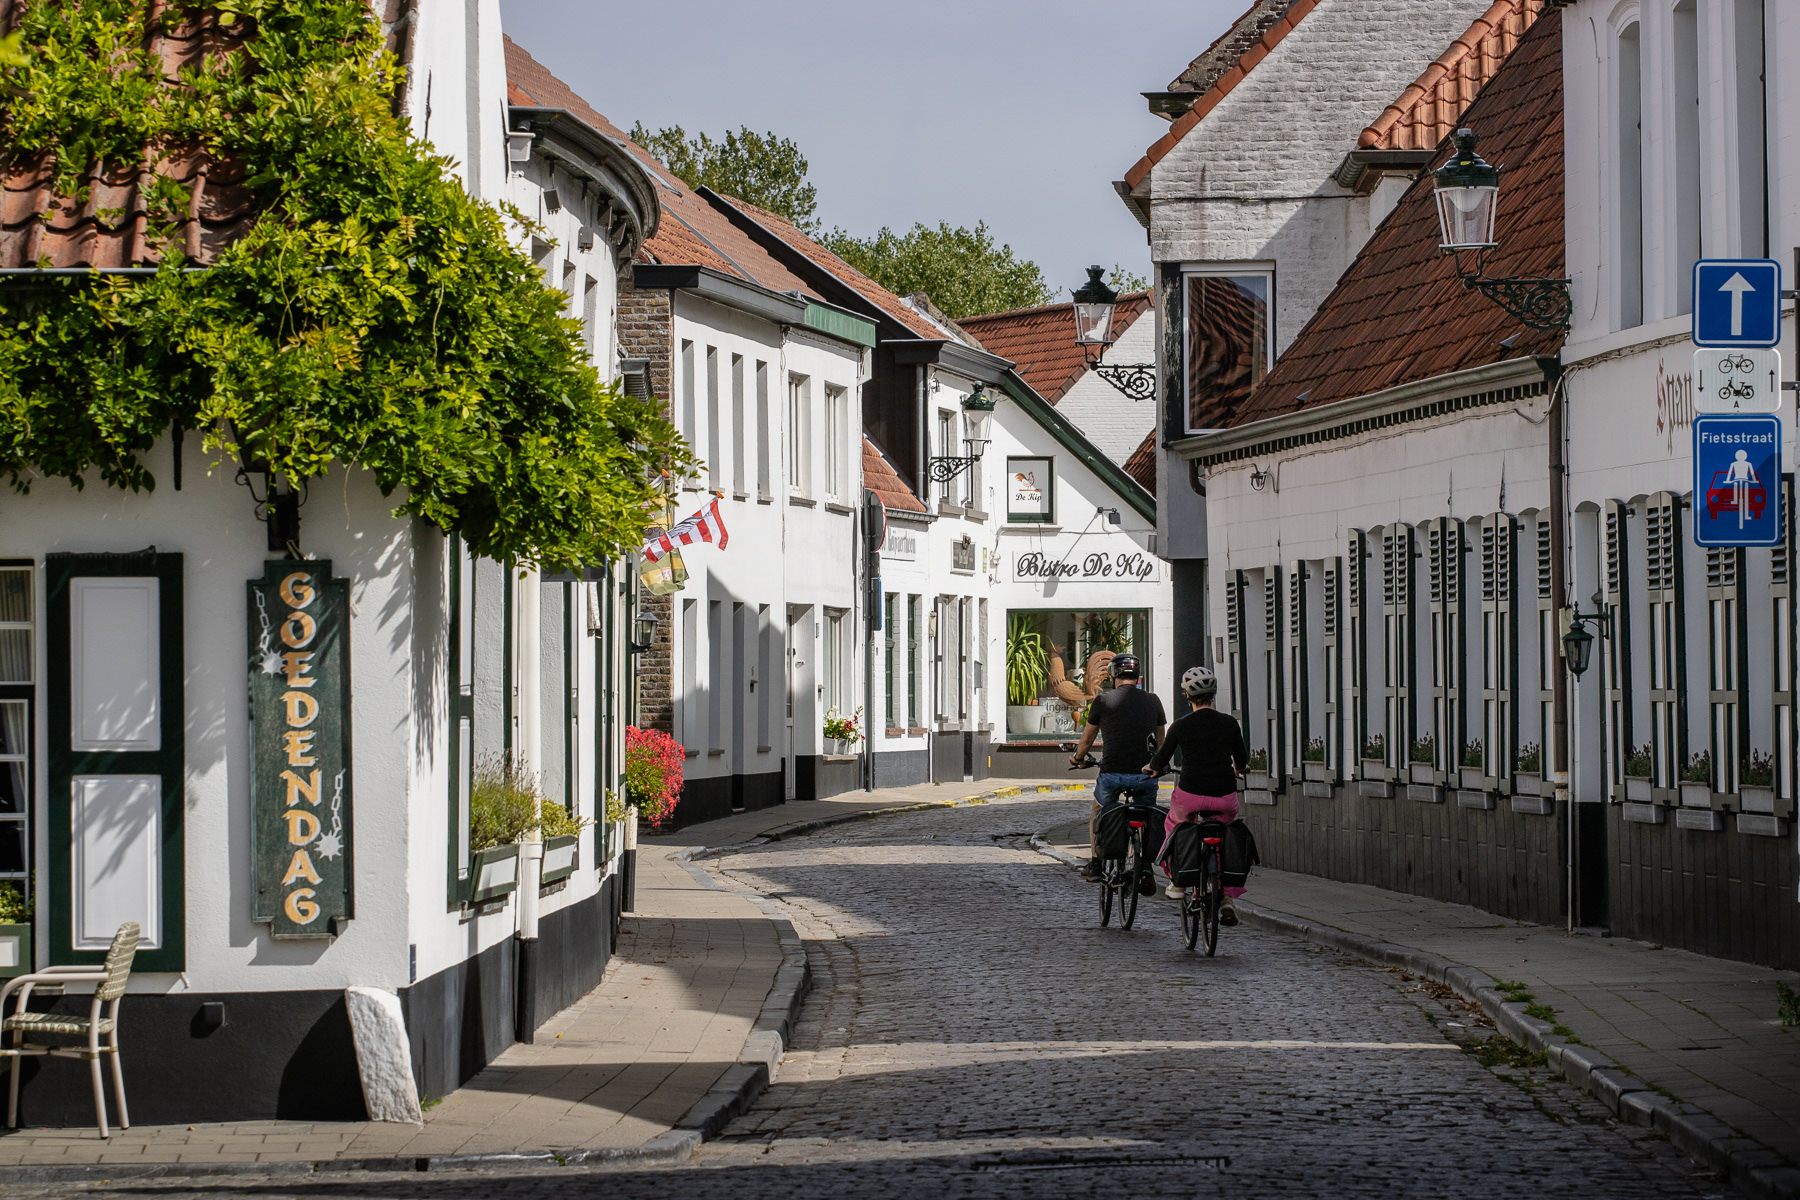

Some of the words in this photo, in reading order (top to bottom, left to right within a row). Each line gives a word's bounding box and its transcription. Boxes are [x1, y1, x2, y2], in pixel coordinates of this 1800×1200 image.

[1656, 356, 1695, 457] Span
[1733, 400, 1740, 409] A
[1701, 432, 1773, 444] Fietsstraat
[1015, 493, 1026, 501] De
[1028, 493, 1042, 503] Kip
[1017, 552, 1080, 577] Bistro
[1082, 552, 1113, 577] De
[1115, 552, 1153, 583] Kip
[1055, 717, 1069, 726] via
[279, 571, 324, 925] GOEDENDAG
